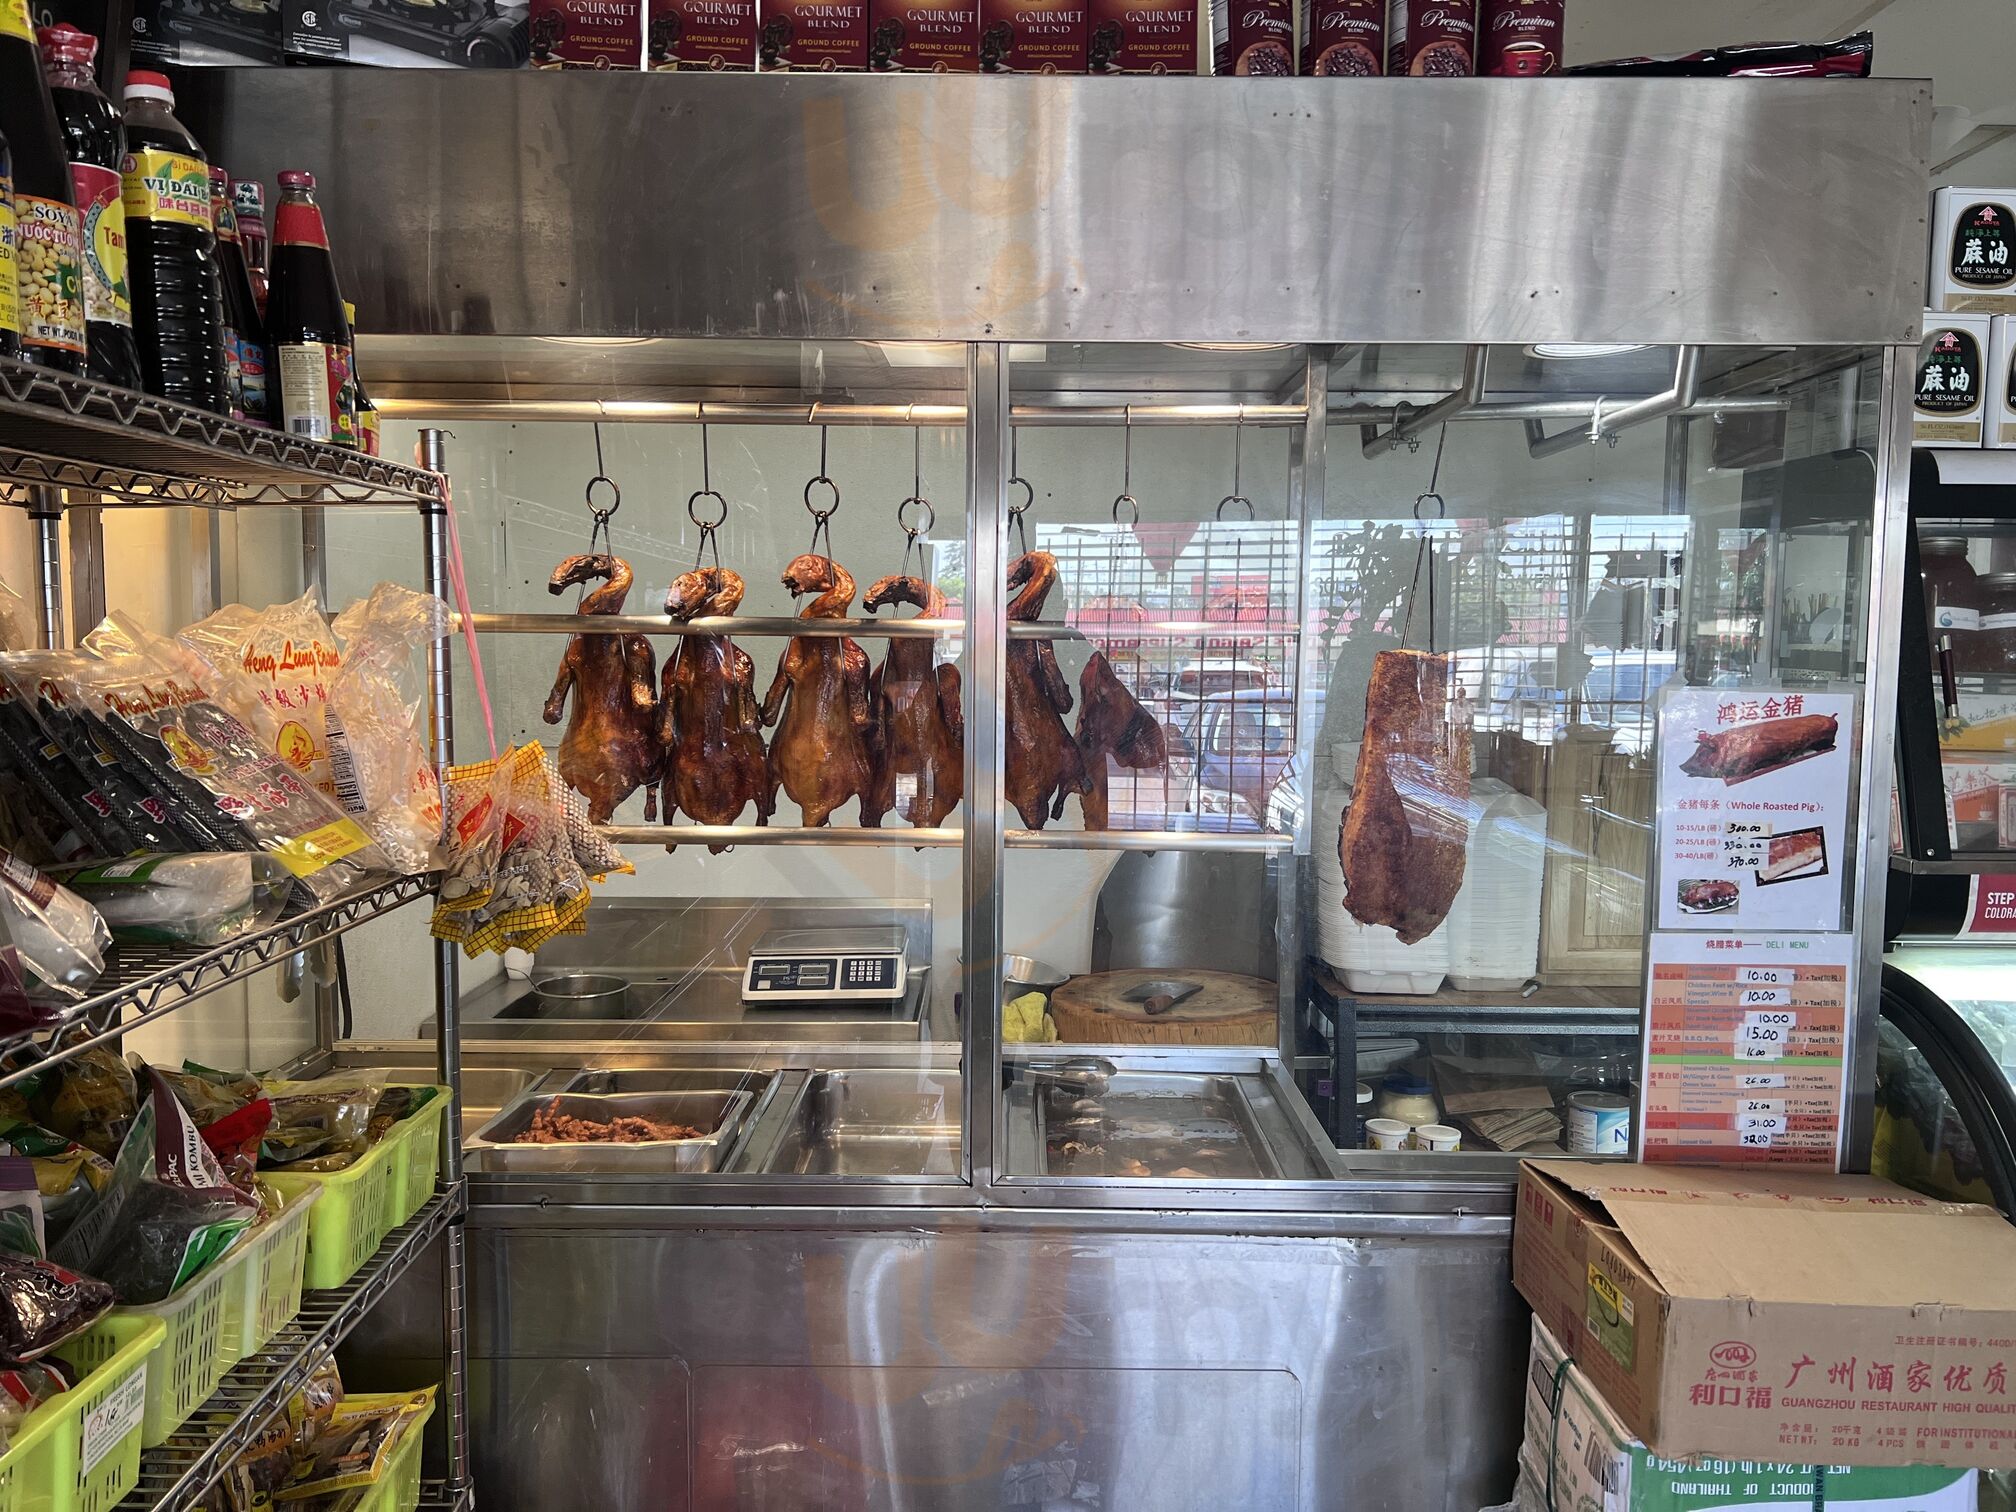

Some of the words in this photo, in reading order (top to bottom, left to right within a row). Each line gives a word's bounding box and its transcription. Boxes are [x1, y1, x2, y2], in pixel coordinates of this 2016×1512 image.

[567, 0, 636, 16] GOURMET
[683, 0, 753, 16] GOURMET
[795, 5, 863, 18] GOURMET
[580, 16, 624, 26] BLEND
[697, 16, 739, 26] BLEND
[907, 9, 975, 24] GOURMET
[1015, 11, 1084, 23] GOURMET
[1126, 10, 1194, 23] GOURMET
[1242, 9, 1293, 33] Premium
[1322, 10, 1380, 33] Premium
[1420, 9, 1474, 32] Premium
[1493, 10, 1556, 32] Premium
[808, 19, 850, 29] BLEND
[920, 24, 962, 34] BLEND
[1028, 25, 1071, 33] BLEND
[1138, 25, 1181, 33] BLEND
[570, 34, 603, 44] GROUND
[605, 36, 634, 46] COFFEE
[686, 34, 718, 44] GROUND
[721, 36, 749, 45] COFFEE
[797, 38, 830, 47] GROUND
[833, 38, 860, 47] COFFEE
[909, 42, 942, 51] GROUND
[944, 43, 972, 52] COFFEE
[1128, 43, 1161, 51] GROUND
[1163, 43, 1190, 51] COFFEE
[34, 206, 74, 227] SOYA
[1955, 266, 1972, 274] PURE
[1975, 267, 1999, 275] SESAME
[1717, 694, 1804, 725] 鸿运金猪
[1678, 799, 1720, 810] 金猪每条
[1762, 801, 1798, 811] Roasted
[1727, 856, 1760, 867] 370.00
[1987, 892, 2015, 905] STEP
[1766, 941, 1785, 949] DELI
[1790, 941, 1809, 949] MENU
[1747, 970, 1777, 982] 10.00
[1747, 991, 1776, 1002] 10.00
[1759, 1014, 1789, 1023] 10.00
[1746, 1026, 1778, 1041] 15.00
[1745, 1076, 1771, 1084] 26.00
[1748, 1101, 1770, 1110] 26.00
[1748, 1119, 1776, 1128] 31.00
[187, 1126, 198, 1172] KOMBU
[1785, 1354, 2009, 1394] 广州酒家优质
[1689, 1384, 1773, 1410] 利口福
[1782, 1397, 1855, 1410] GUANGZHOU
[1861, 1400, 1937, 1412] RESTAURANT
[1943, 1403, 1971, 1412] HIGH
[1917, 1428, 1938, 1437] FOR
[1779, 1435, 1798, 1444] NET
[1832, 1437, 1844, 1446] 20
[1848, 1438, 1860, 1447] KG
[1878, 1439, 1884, 1447] 4
[1886, 1439, 1904, 1448] PCS
[1671, 1481, 1732, 1496] THAILAND
[1743, 1483, 1758, 1496] OF
[1769, 1483, 1815, 1496] ODUCT
